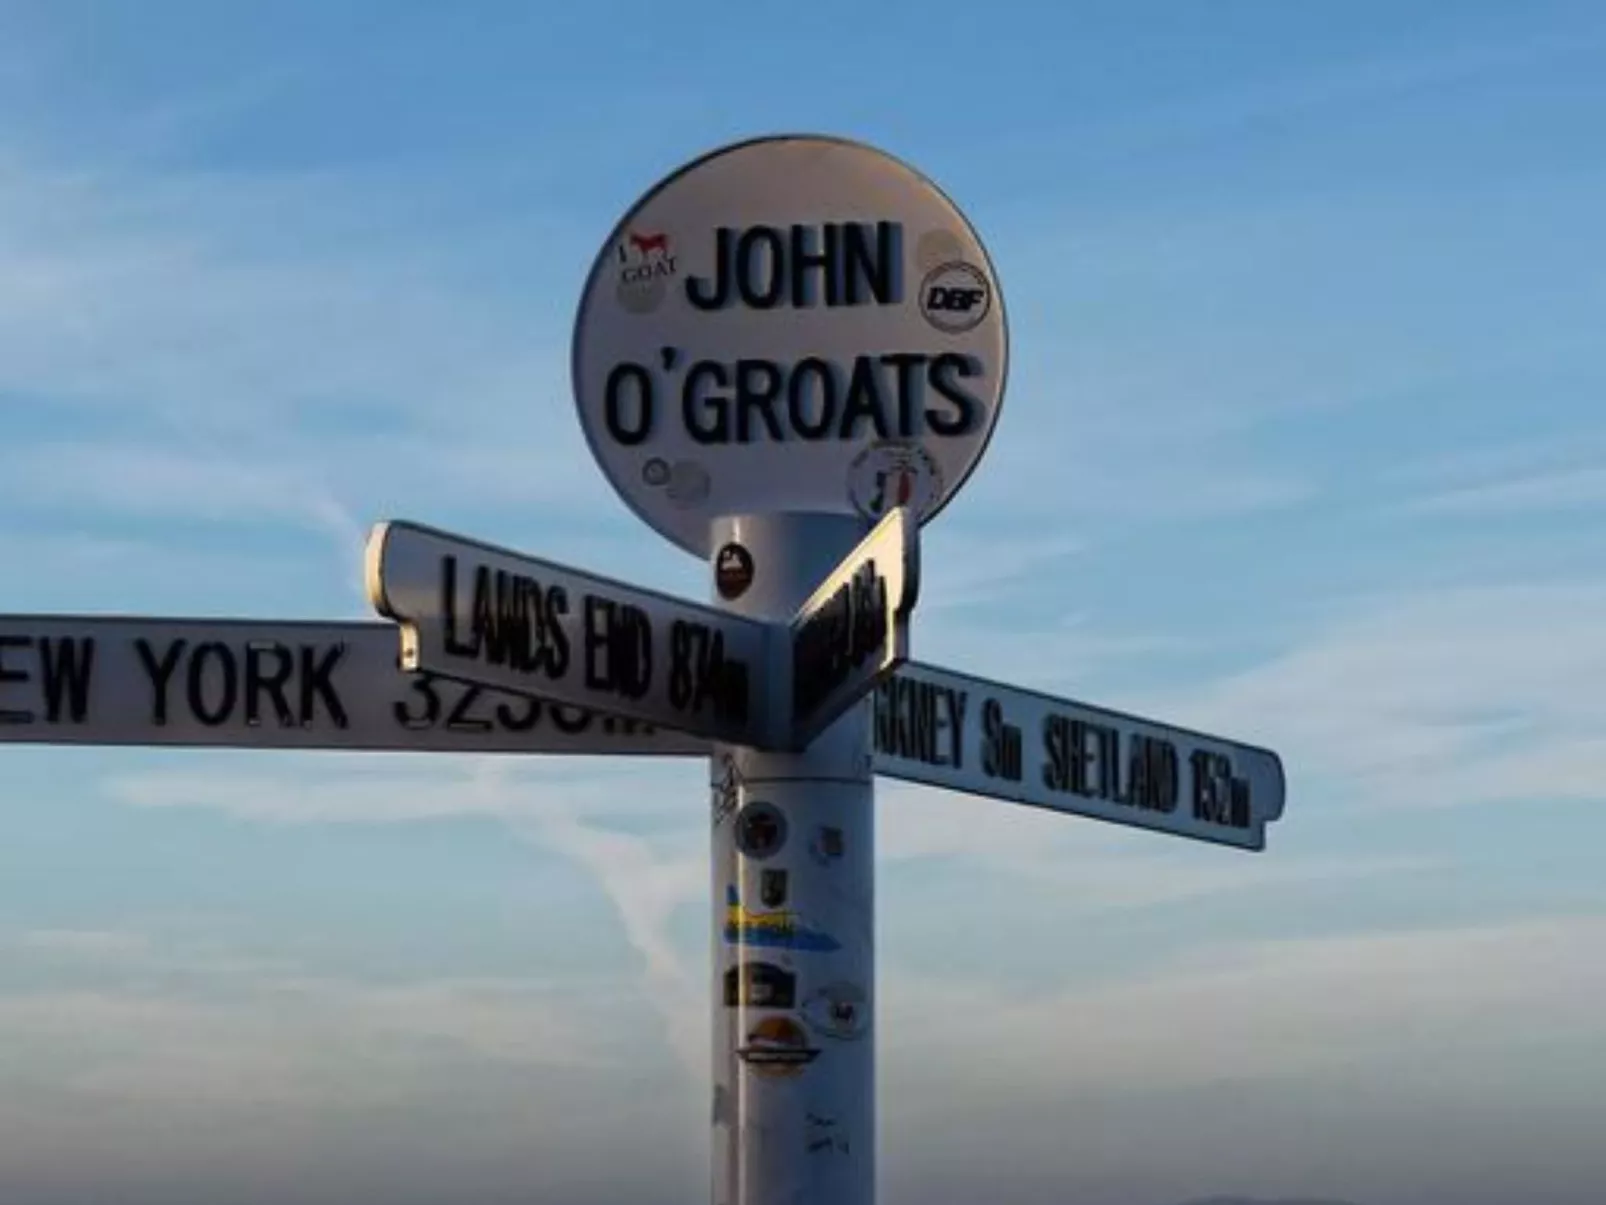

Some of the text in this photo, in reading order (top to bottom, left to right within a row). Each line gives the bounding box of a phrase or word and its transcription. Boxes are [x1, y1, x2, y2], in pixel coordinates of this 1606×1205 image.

[621, 256, 677, 284] GOAT
[684, 221, 900, 311] JOHN
[927, 286, 985, 311] DBF
[604, 346, 983, 446] O'GROATS
[442, 555, 570, 680] LANDS
[583, 594, 653, 698] END
[133, 637, 349, 729] YORK
[1042, 713, 1180, 813] SHETLAND
